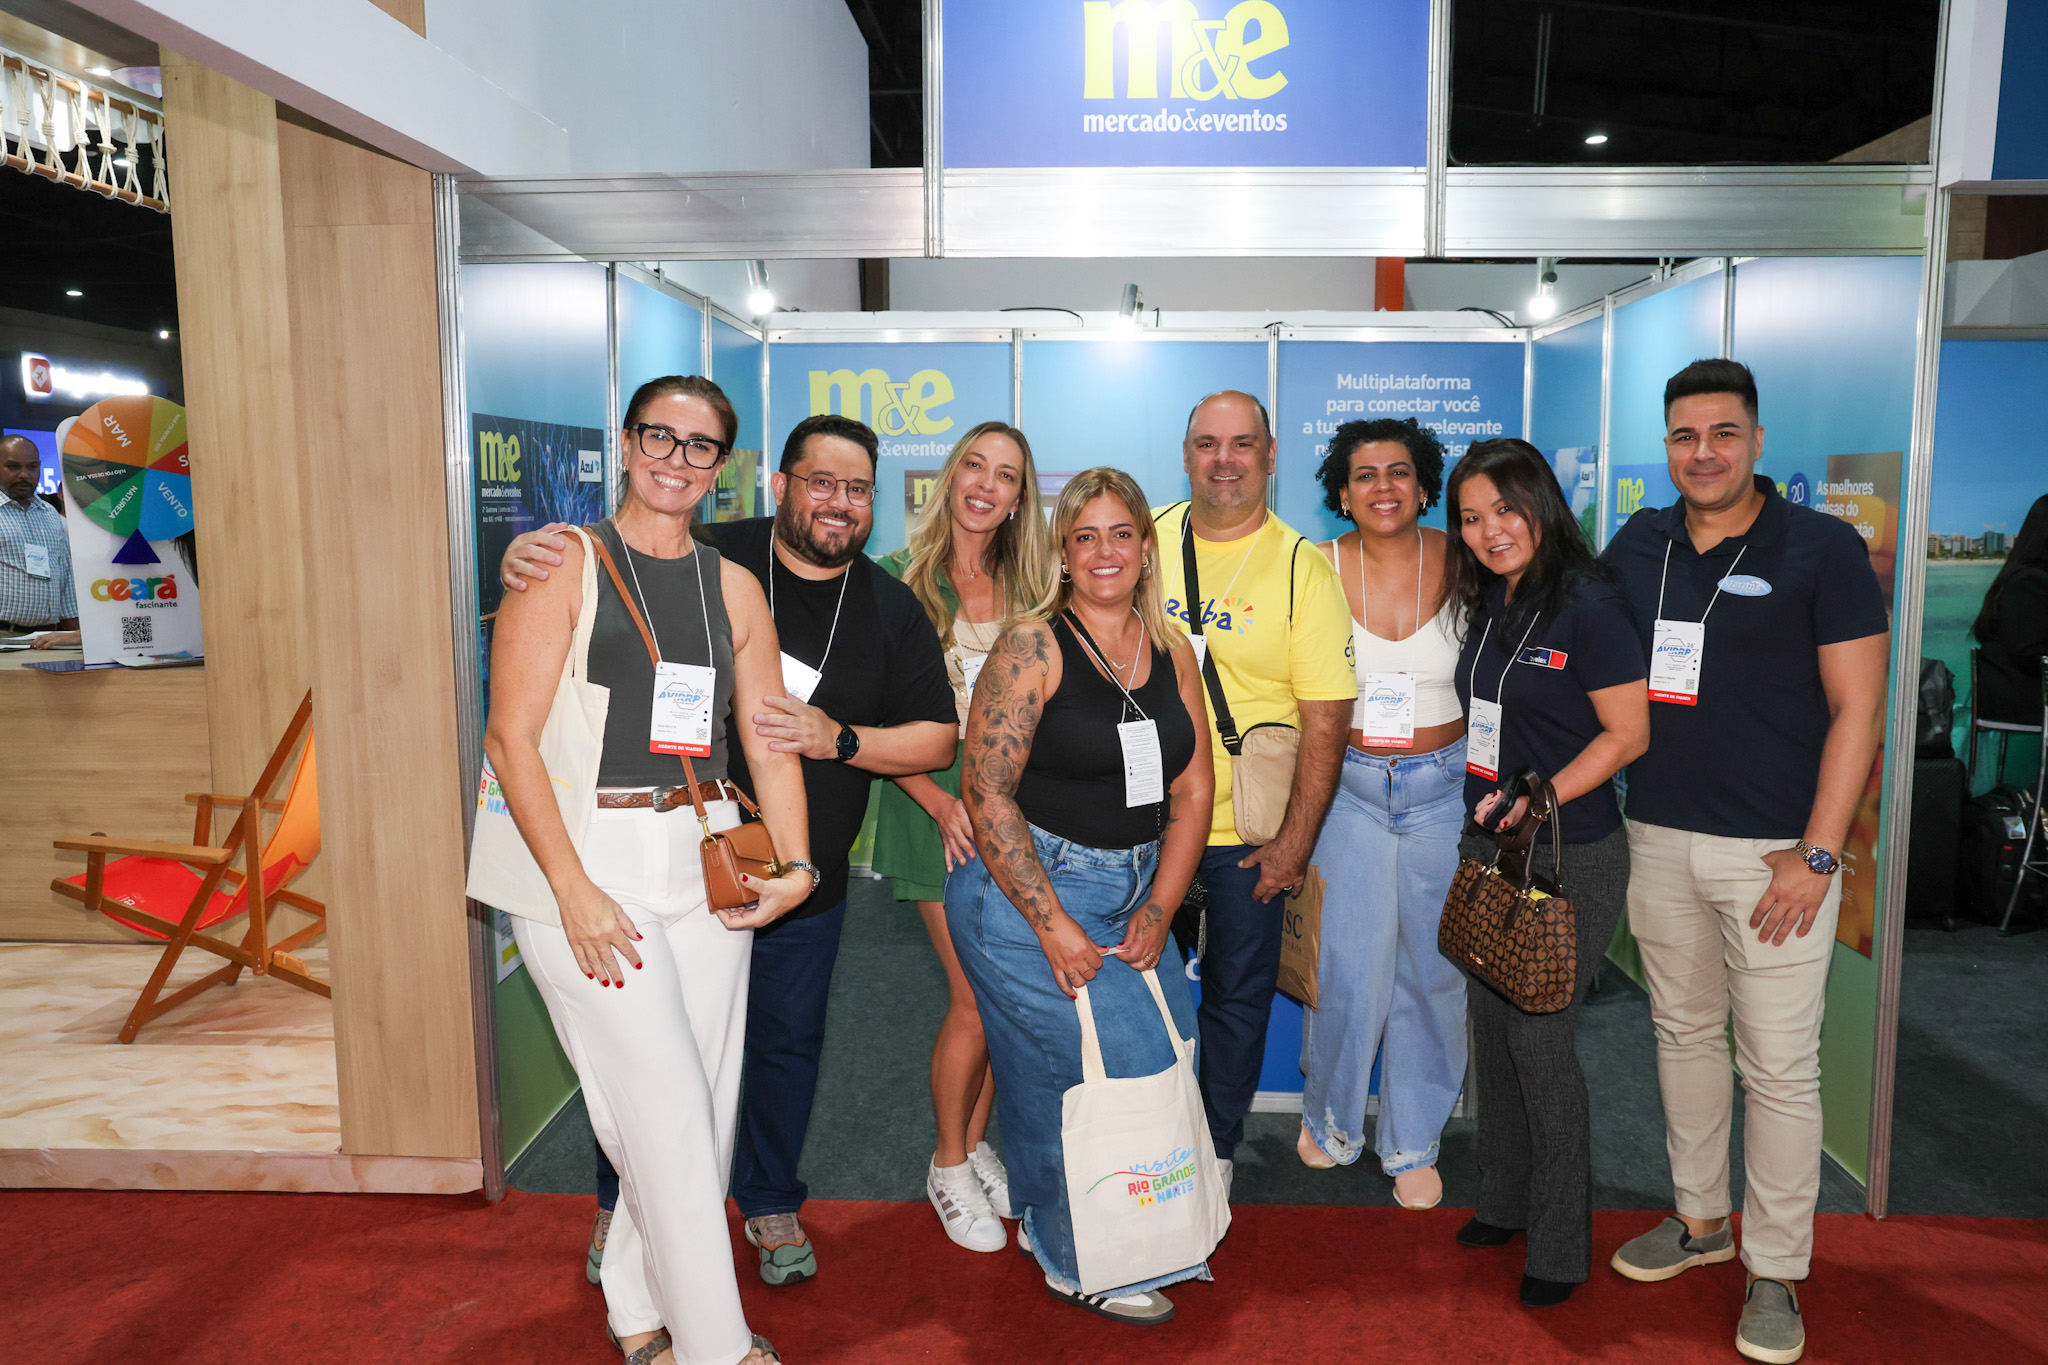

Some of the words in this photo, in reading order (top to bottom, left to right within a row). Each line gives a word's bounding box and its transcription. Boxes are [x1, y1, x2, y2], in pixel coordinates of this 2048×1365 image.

[1084, 0, 1289, 101] m&e
[1083, 108, 1288, 133] mercado&eventos
[1337, 373, 1471, 394] Multiplataforma
[808, 368, 955, 437] m&e
[1326, 400, 1364, 415] para
[1368, 398, 1440, 412] conectar
[1443, 395, 1481, 412] você
[103, 415, 132, 448] MAR
[1302, 422, 1313, 434] a
[1425, 419, 1503, 435] relevante
[179, 455, 189, 467] S
[480, 431, 521, 482] m&e
[580, 459, 594, 473] Azul
[1791, 482, 1805, 503] 20
[1816, 480, 1828, 495] As
[1830, 479, 1874, 495] melhores
[108, 485, 138, 519] NATUREZA
[158, 482, 188, 518] VENTO
[1846, 500, 1859, 517] do
[90, 574, 177, 602] ceará
[135, 601, 178, 609] fascinante
[1129, 1147, 1195, 1174] visite
[1152, 1162, 1196, 1191] GRANDE
[1157, 1179, 1194, 1203] NORTE
